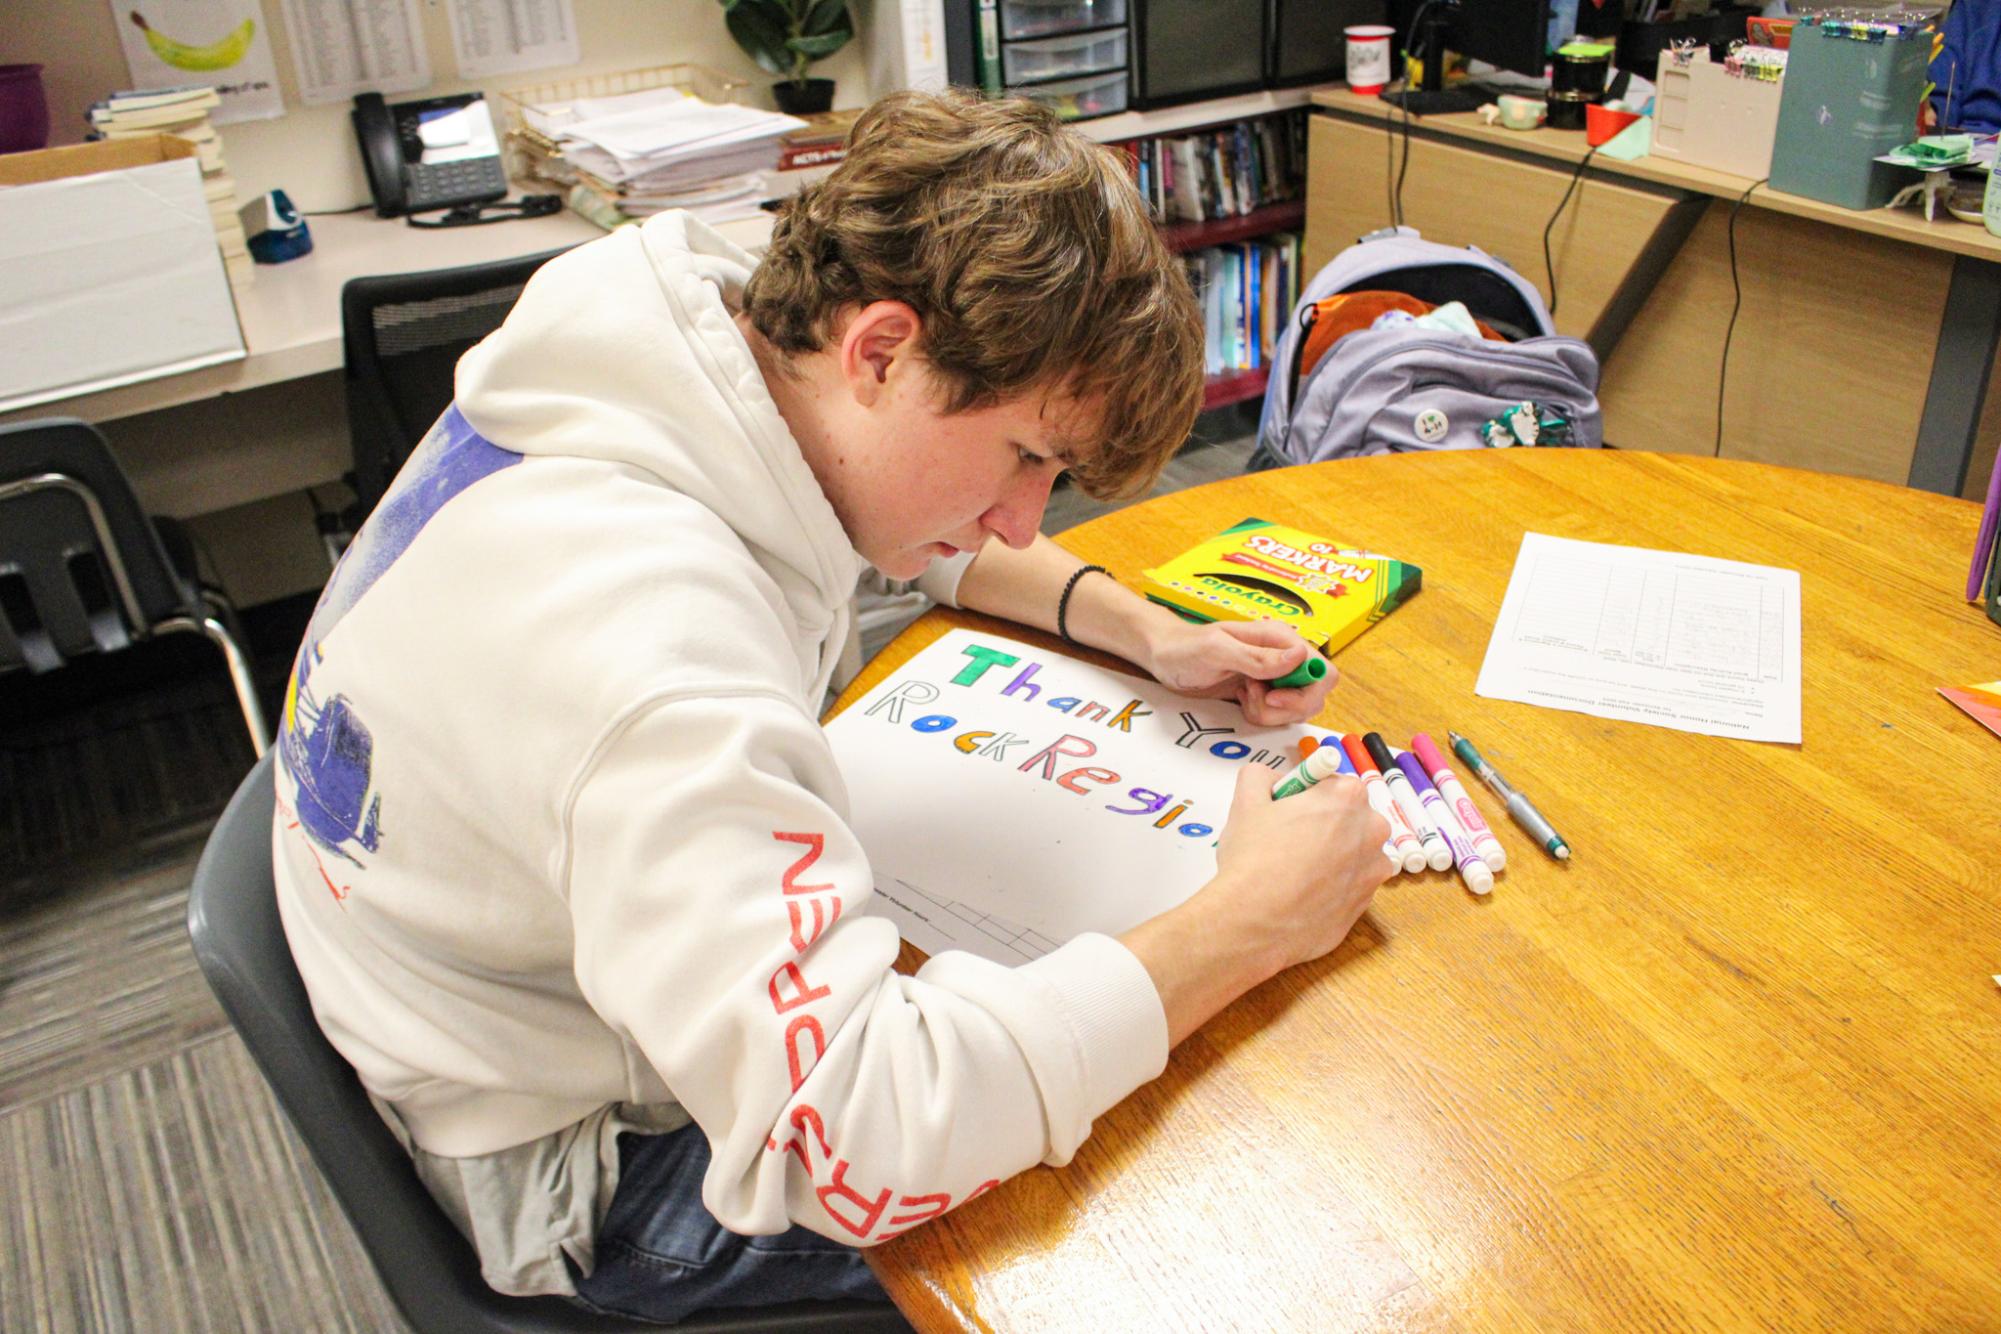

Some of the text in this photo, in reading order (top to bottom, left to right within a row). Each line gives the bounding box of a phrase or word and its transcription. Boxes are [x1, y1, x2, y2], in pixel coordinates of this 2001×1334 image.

[1244, 535, 1373, 583] MARKERS
[1309, 543, 1334, 555] 10
[1201, 576, 1301, 617] Crayola
[949, 643, 1153, 733] Thank
[863, 679, 1218, 848] Rock Regio
